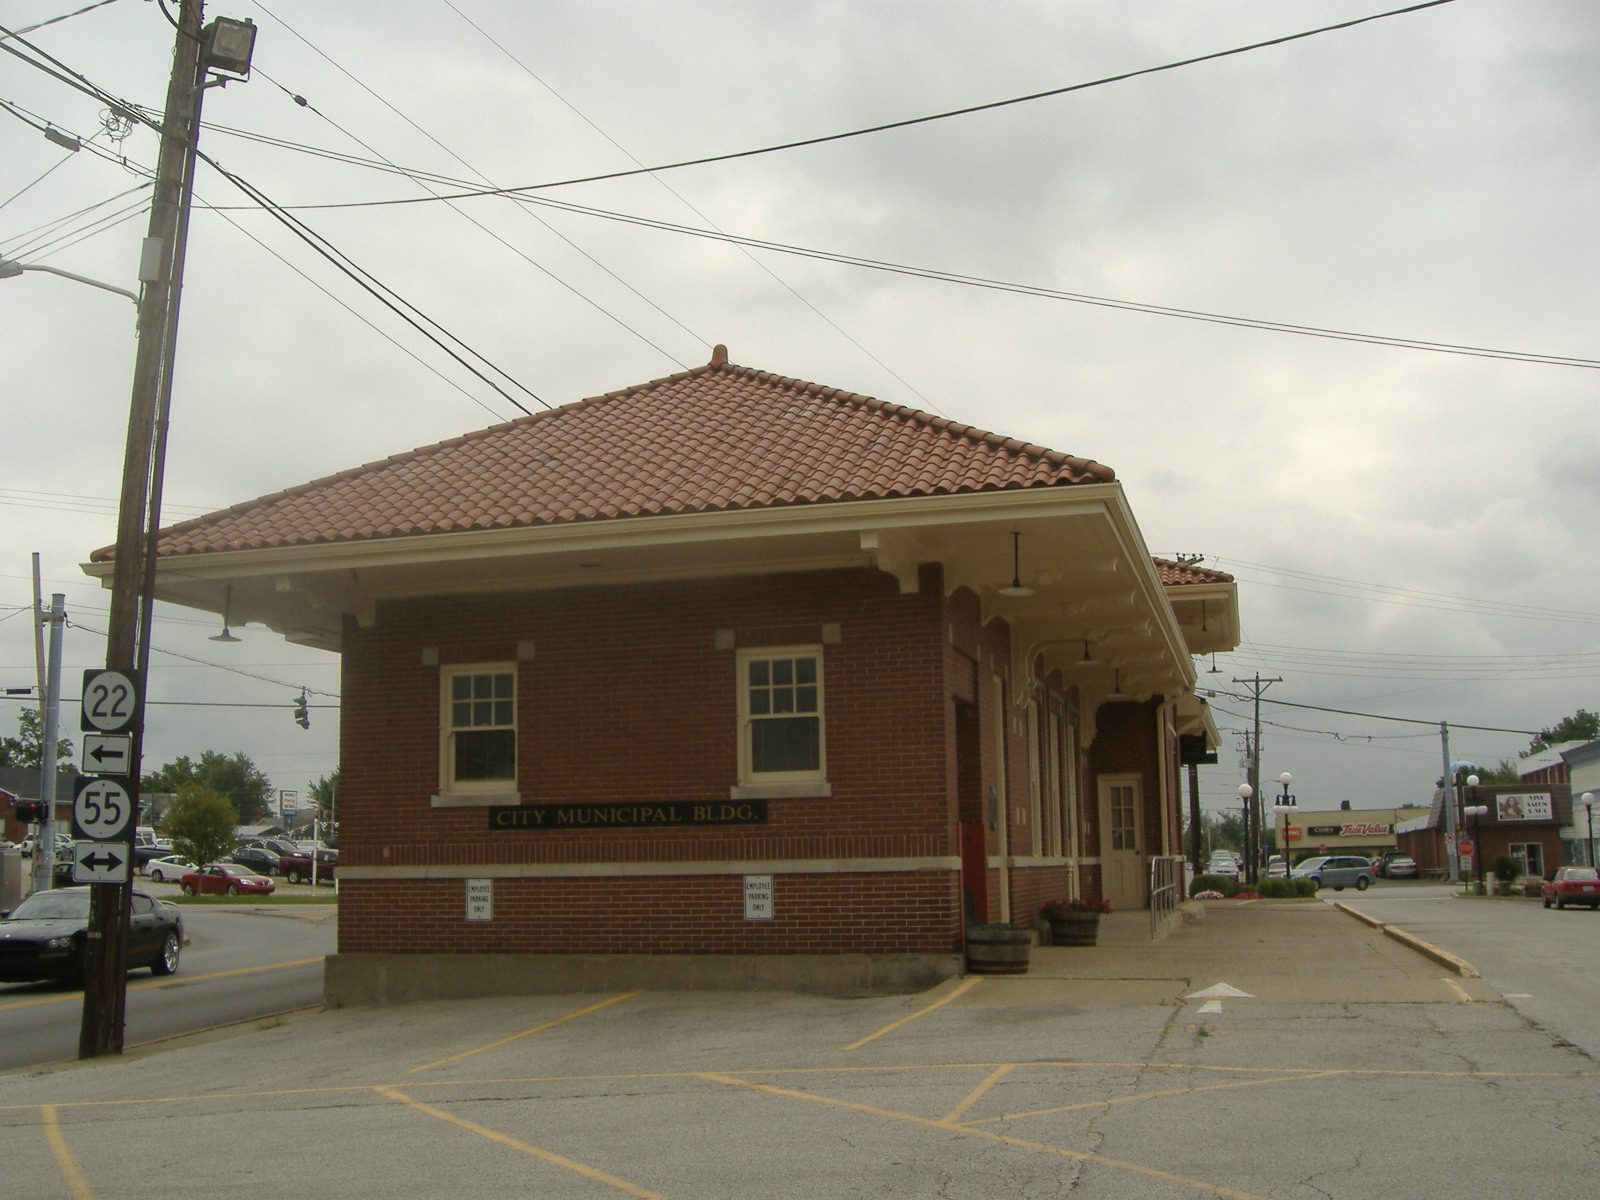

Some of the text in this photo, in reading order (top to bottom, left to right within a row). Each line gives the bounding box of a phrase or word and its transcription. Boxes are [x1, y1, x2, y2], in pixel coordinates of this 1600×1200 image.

[92, 685, 127, 717] 22
[84, 792, 120, 825] 55
[496, 805, 758, 826] CITY MUNICIPAL BLDG.
[746, 882, 771, 890] EMPLOYEE
